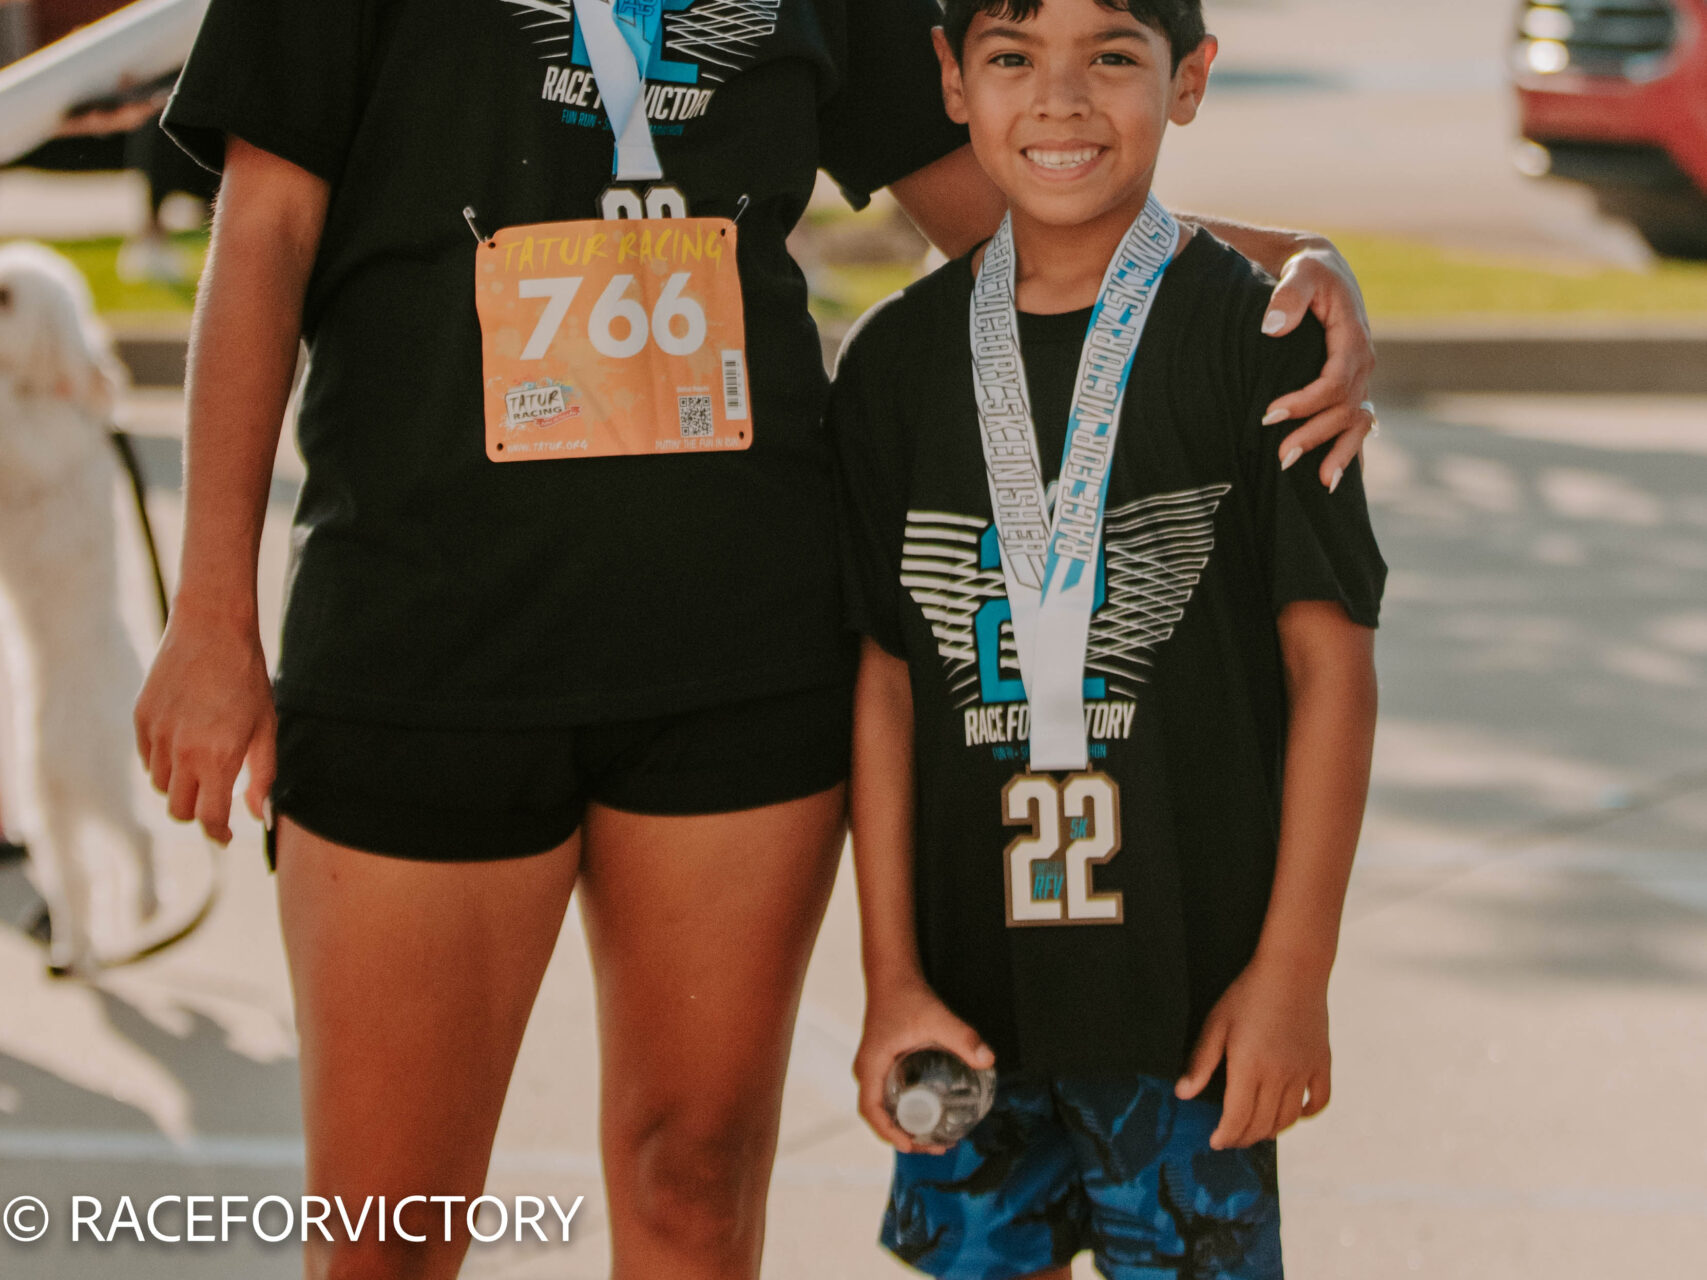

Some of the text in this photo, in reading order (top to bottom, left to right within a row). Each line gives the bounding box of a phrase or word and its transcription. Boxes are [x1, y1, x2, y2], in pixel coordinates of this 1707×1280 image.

[541, 65, 596, 107] RACE
[502, 223, 723, 272] TATUR RACING
[518, 271, 708, 361] 766
[1103, 273, 1151, 317] 5K
[974, 288, 1021, 392] VICTORY
[1075, 311, 1136, 425] VICTORY
[510, 390, 560, 410] TATUR
[513, 407, 562, 420] RACING
[982, 396, 1027, 436] 5K
[1066, 427, 1110, 486] FOR
[987, 439, 1048, 556] FINISHER
[1053, 486, 1100, 564] RACE
[965, 705, 1006, 747] RACE
[1007, 777, 1118, 921] 22
[1069, 817, 1089, 840] 5K
[1032, 872, 1065, 901] RFV
